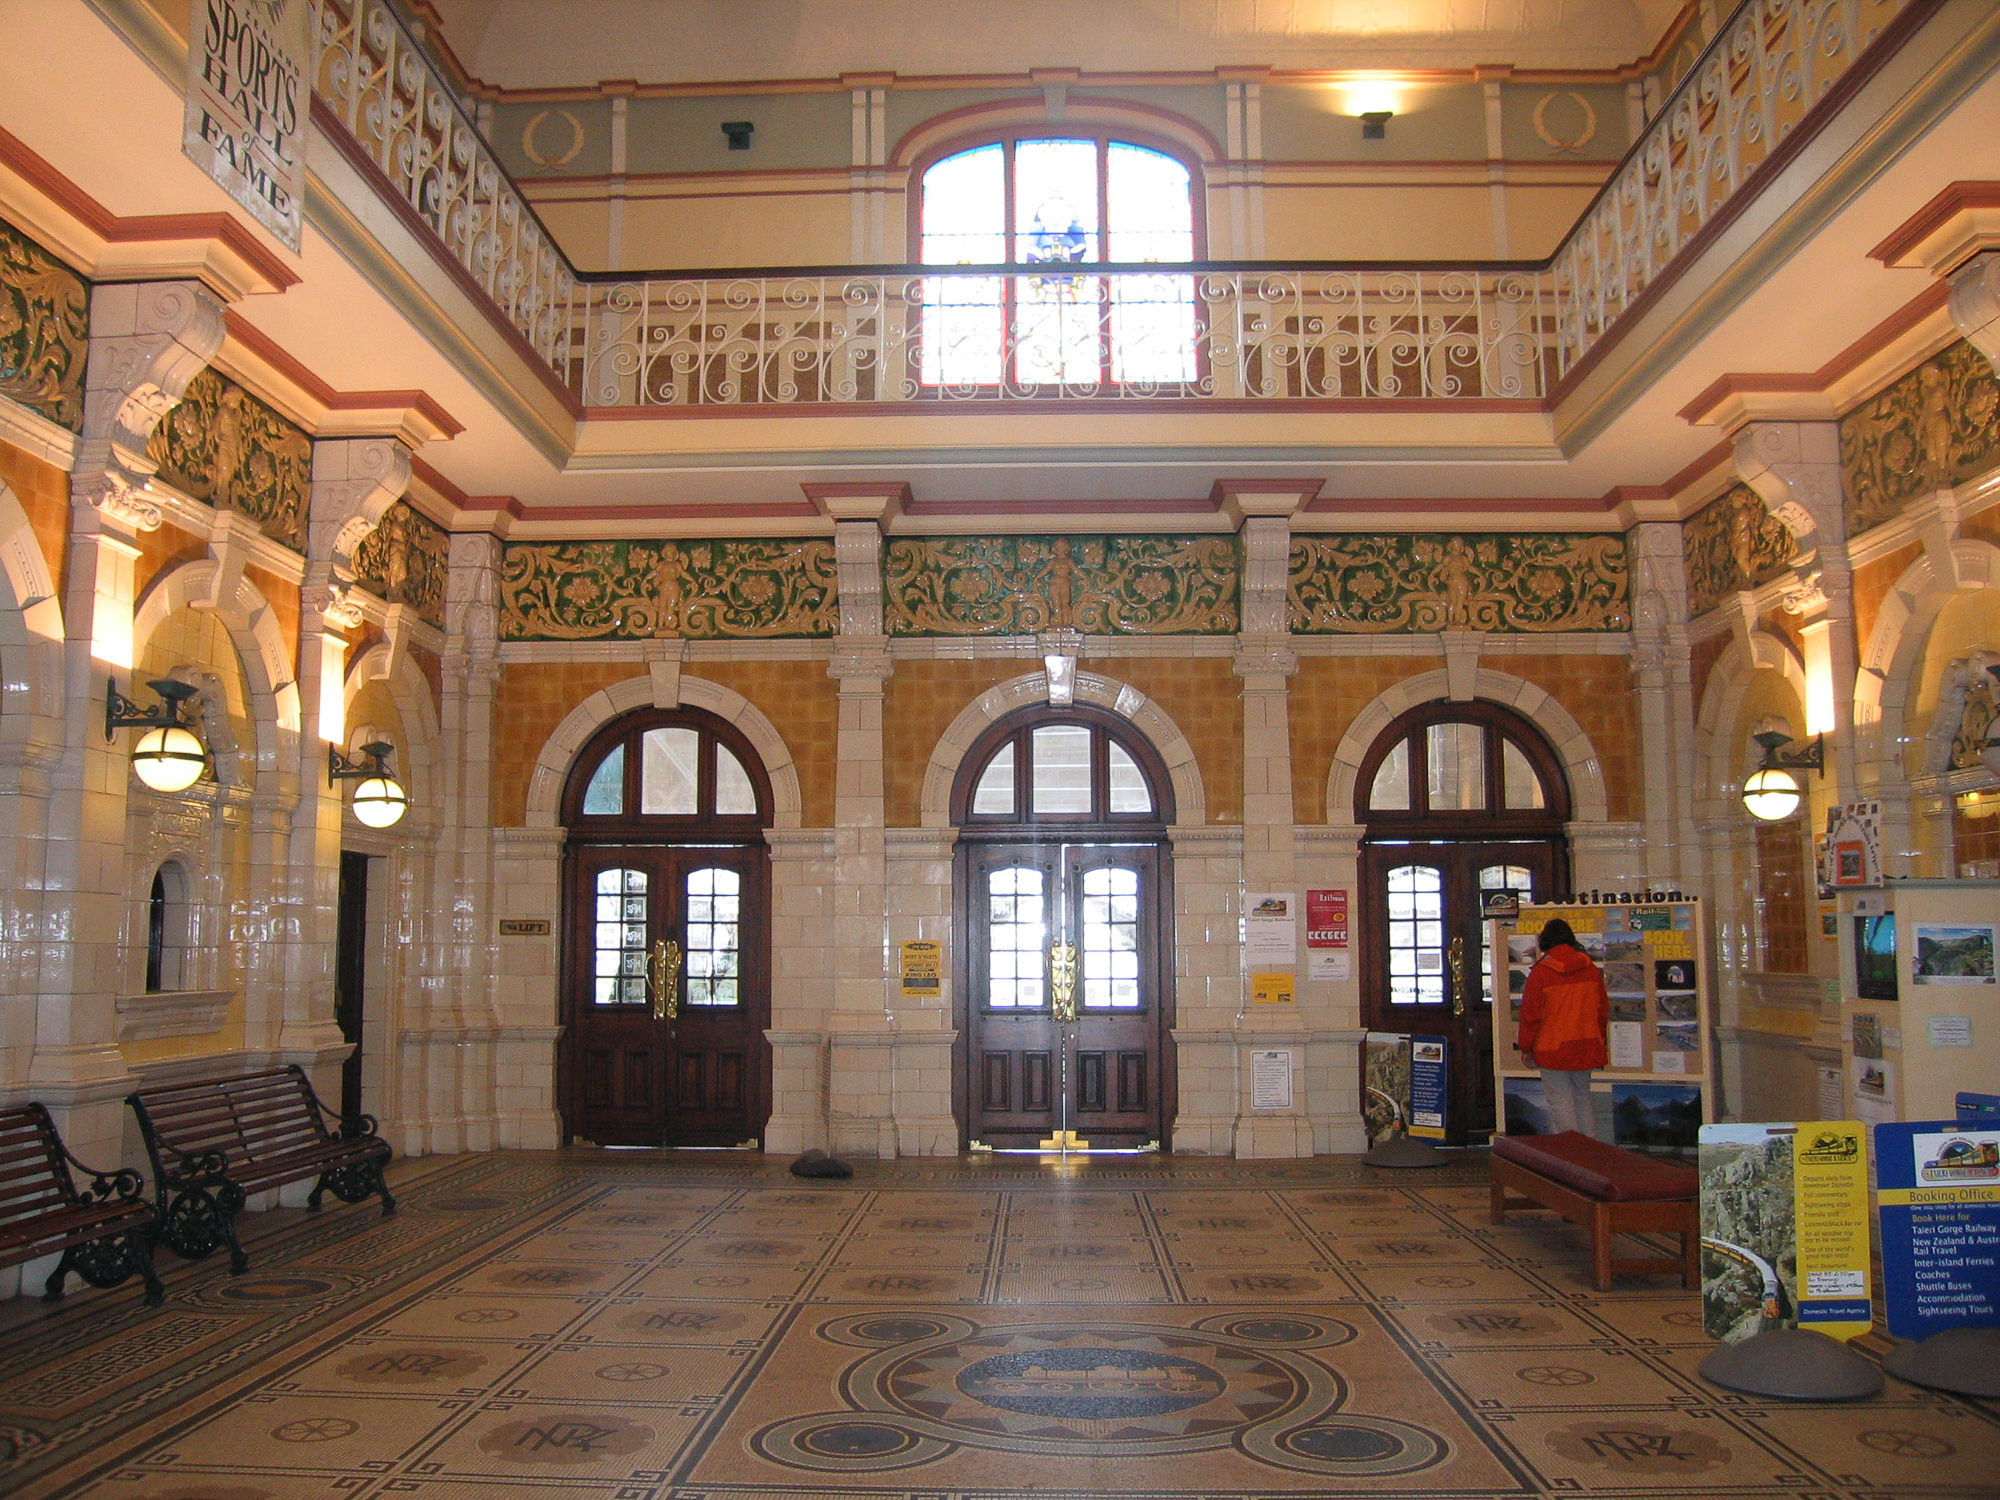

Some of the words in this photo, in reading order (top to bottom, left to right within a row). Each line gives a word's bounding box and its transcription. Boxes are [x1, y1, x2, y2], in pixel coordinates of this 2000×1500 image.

[205, 0, 297, 135] SPORTS
[201, 48, 293, 166] HALL
[198, 106, 291, 218] FAME
[518, 924, 544, 932] LIFT
[1644, 930, 1685, 945] BOOK
[1654, 945, 1692, 958] HERE
[1909, 1190, 1956, 1202] Booking
[1959, 1189, 1993, 1200] Office
[1912, 1214, 1933, 1223] Book
[1935, 1213, 1956, 1222] Here
[1958, 1212, 1970, 1222] for
[1911, 1225, 1936, 1234] Taieri
[1937, 1224, 1964, 1235] Gorge
[1965, 1224, 1997, 1234] Railway
[1912, 1238, 1931, 1246] New
[1932, 1236, 1966, 1246] Zealand
[1967, 1236, 1974, 1244] &
[1913, 1247, 1929, 1255] Rail
[1931, 1246, 1957, 1255] Travel
[1914, 1258, 1964, 1268] Inter-island
[1965, 1257, 1995, 1266] Ferries
[1915, 1270, 1950, 1280] Coaches
[1916, 1282, 1946, 1291] Shuttle
[1947, 1281, 1972, 1291] Buses
[1917, 1293, 1986, 1303] Accommodation
[1917, 1305, 1967, 1317] Sightseeing
[1968, 1305, 1994, 1314] Tours
